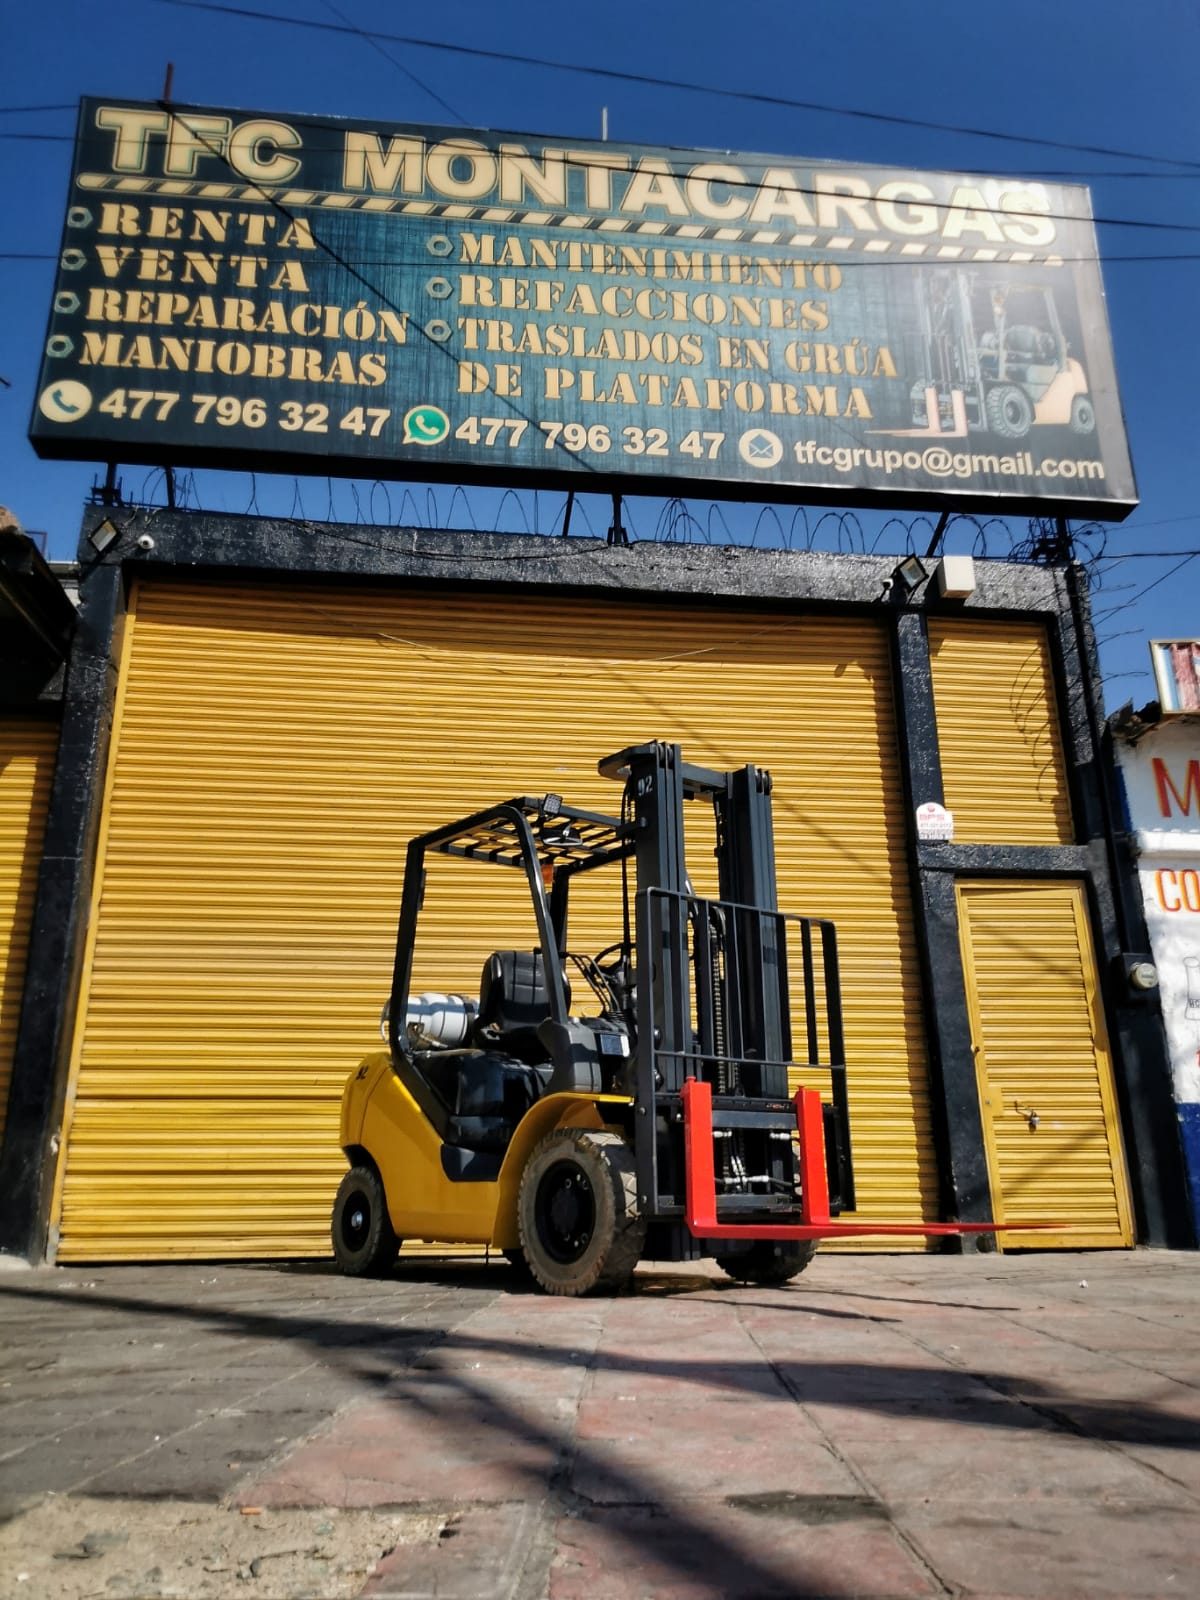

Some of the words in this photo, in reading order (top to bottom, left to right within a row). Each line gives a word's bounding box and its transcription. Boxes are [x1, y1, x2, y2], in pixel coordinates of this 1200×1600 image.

[95, 106, 302, 185] TFC
[342, 129, 1058, 247] MONTACARGAS
[97, 202, 317, 250] RENTA
[95, 244, 311, 293] VENTA
[459, 232, 843, 292] MANTENIMIENTO
[85, 288, 411, 345] REPARACIÓN
[458, 274, 831, 332] REFACCIONES
[79, 332, 388, 387] MANIOBRAS
[457, 317, 704, 366] TRASLADOS
[718, 337, 770, 371] EN
[785, 338, 898, 378] GRÚA
[97, 388, 181, 421] 477
[191, 394, 268, 429] 796
[278, 401, 329, 433] 32
[339, 406, 392, 437] 47
[456, 360, 523, 398] DE
[544, 366, 875, 420] PLATAFORMA
[455, 416, 529, 448] 477
[539, 420, 612, 453] 796
[622, 426, 670, 456] 32
[679, 430, 726, 460] 47
[794, 439, 1106, 480] tfcgrupo@gmail.com
